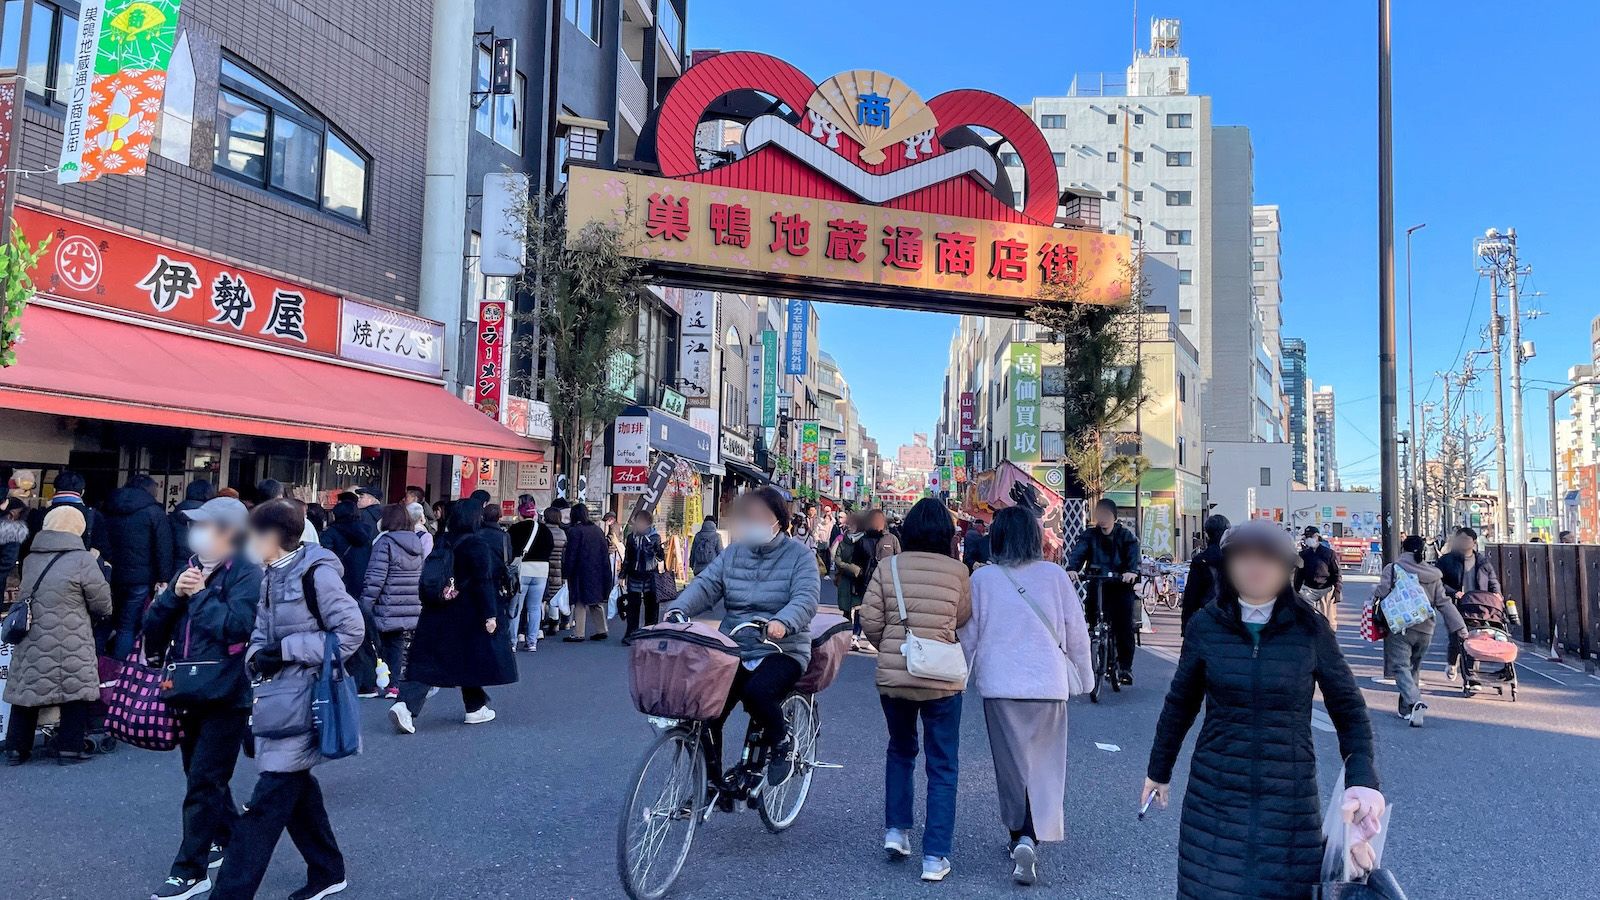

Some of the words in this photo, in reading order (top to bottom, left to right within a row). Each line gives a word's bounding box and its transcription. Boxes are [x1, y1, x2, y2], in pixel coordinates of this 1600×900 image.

[67, 6, 98, 153] 巣鴨地蔵通り商店街
[857, 92, 890, 129] 商
[646, 192, 1079, 286] 巣鴨地蔵通商店街
[137, 256, 306, 342] 伊勢屋
[352, 319, 432, 359] 焼だんご
[479, 325, 498, 396] ラーメン
[1014, 352, 1037, 454] 高価買取
[617, 422, 644, 435] 珈琲
[335, 463, 381, 478] お入り下さい
[616, 449, 636, 457] Coffee
[539, 464, 549, 486] 占い
[616, 467, 645, 482] スカイ
